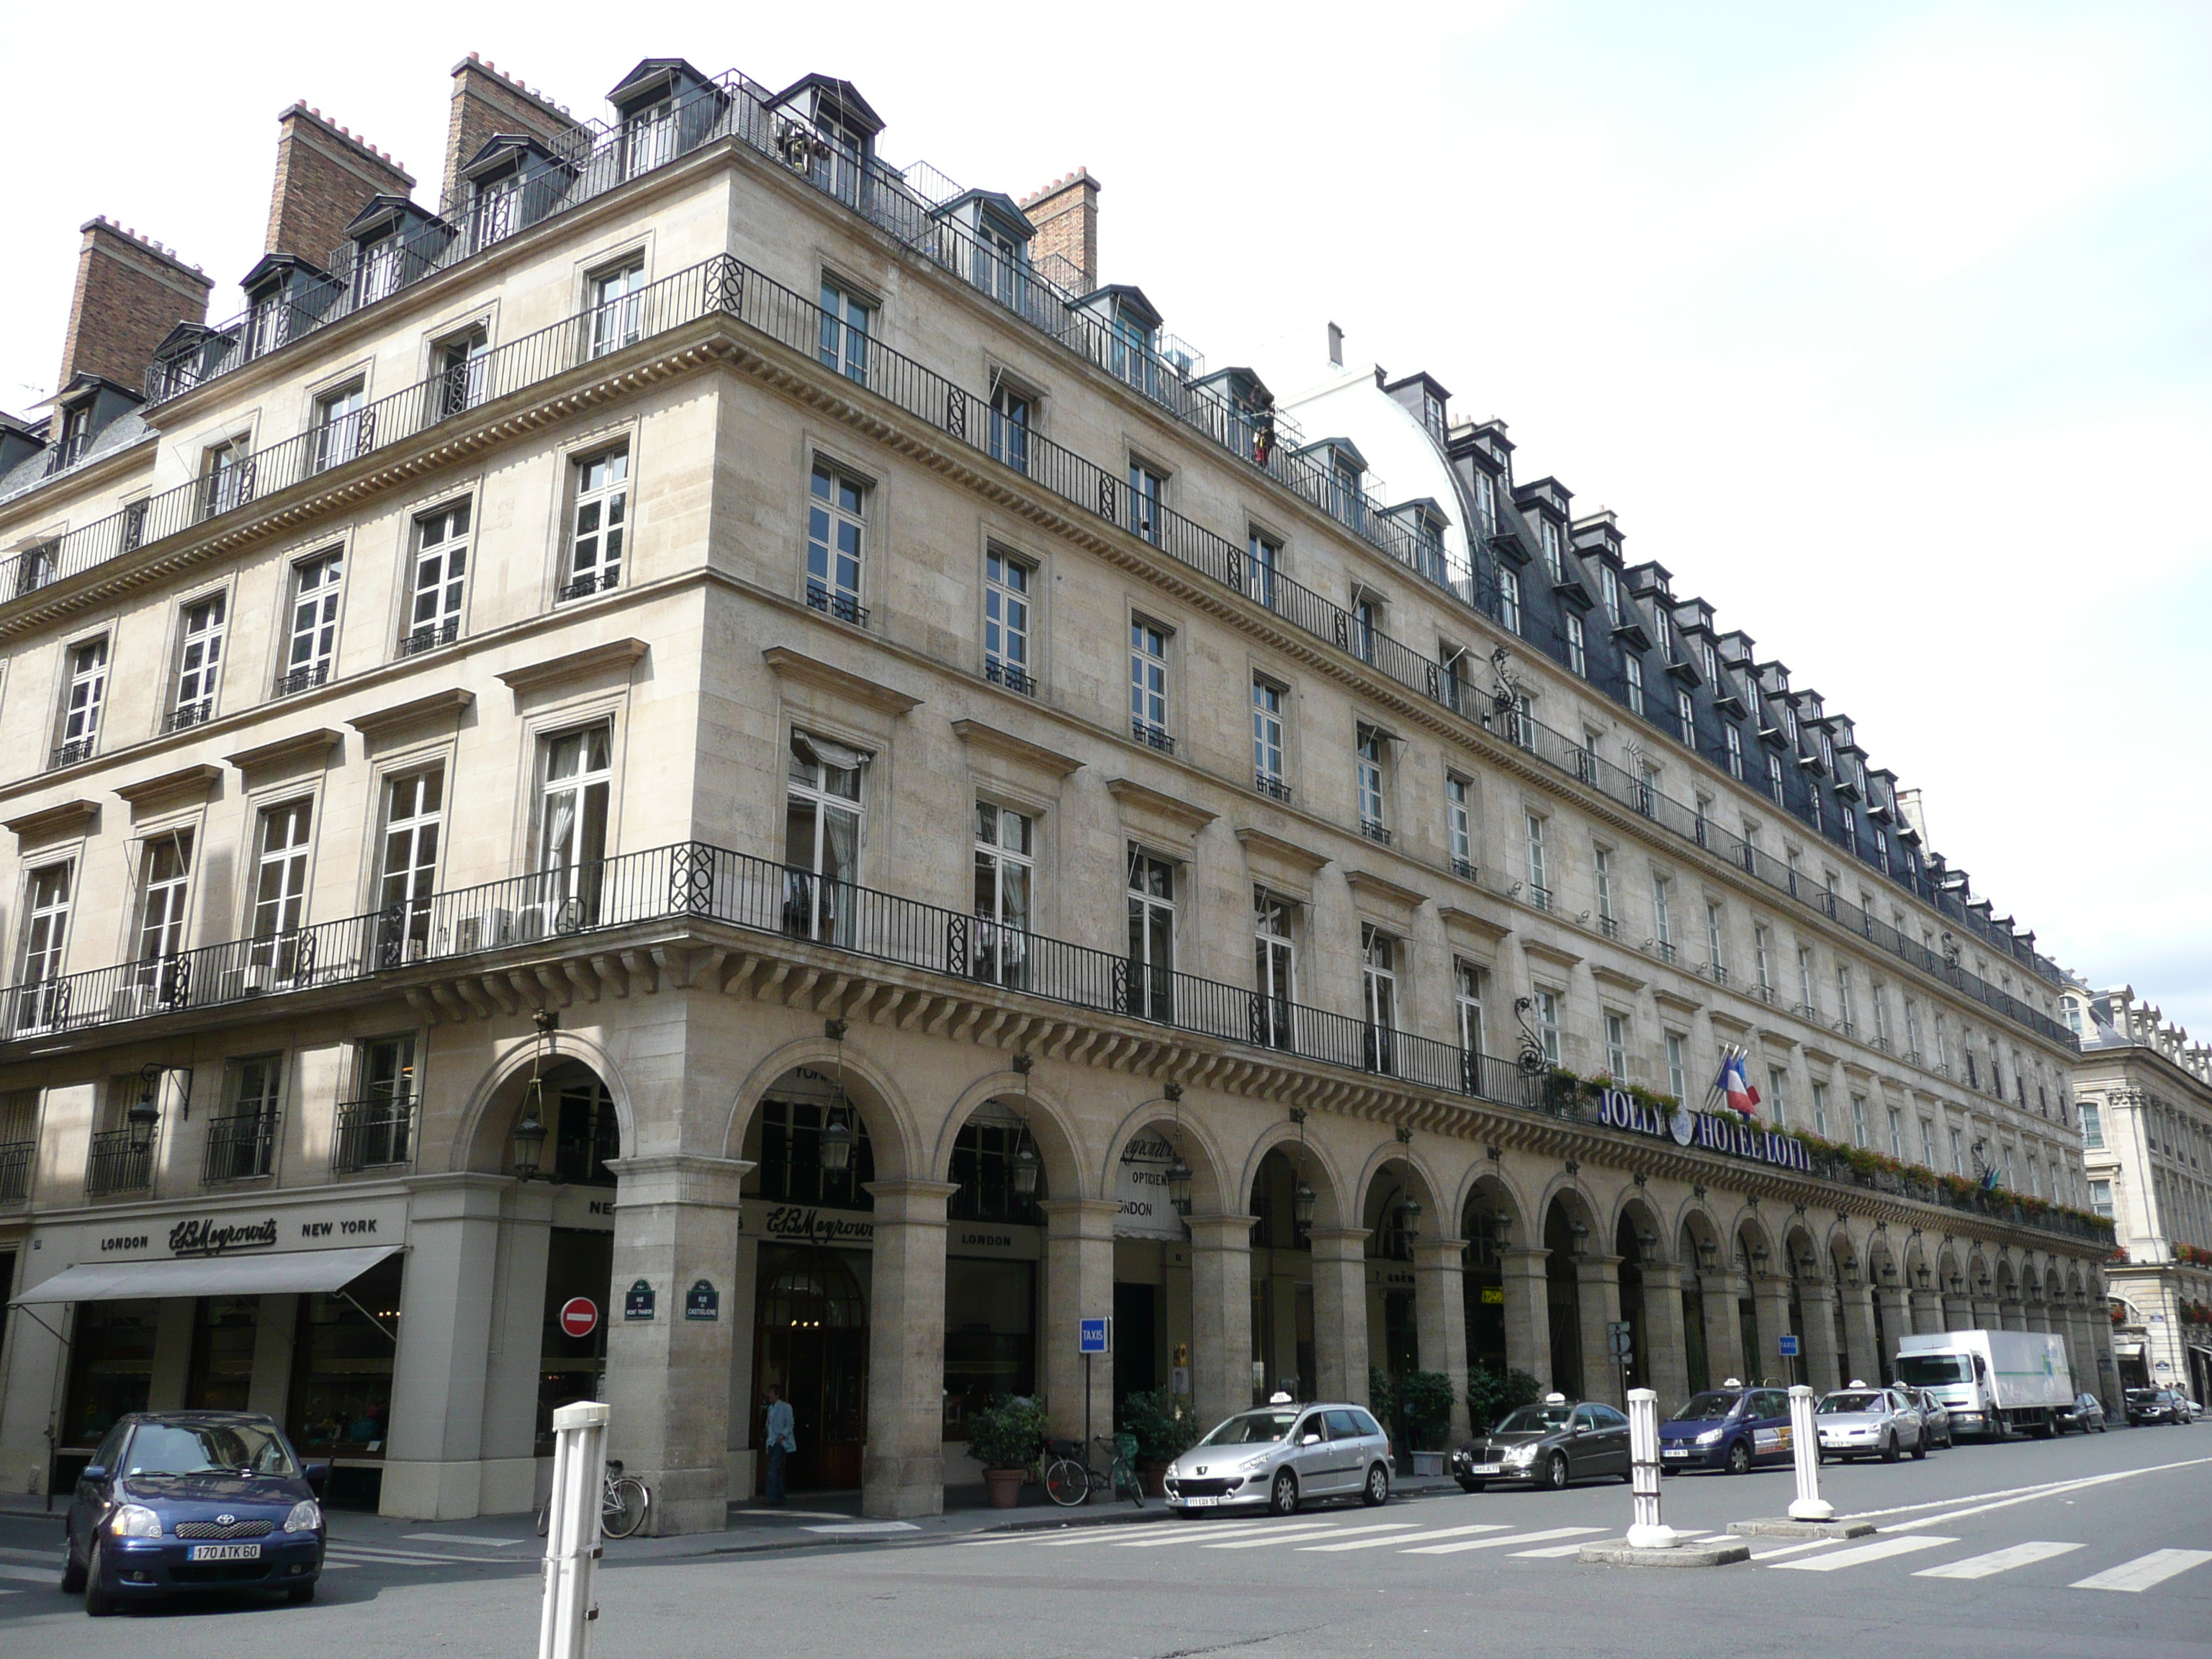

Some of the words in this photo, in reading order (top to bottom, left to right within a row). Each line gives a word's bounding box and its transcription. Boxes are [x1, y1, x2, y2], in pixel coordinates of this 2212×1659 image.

[1599, 1089, 1662, 1136] JOLLY
[1696, 1113, 1762, 1159] HOTEL
[1133, 1172, 1169, 1186] OPTICIEN
[302, 1222, 333, 1237] NEW
[341, 1219, 377, 1233] YORK
[102, 1234, 148, 1251] LONDON
[961, 1233, 1012, 1247] LONDON
[1083, 1329, 1103, 1341] TAXIS
[197, 1547, 217, 1559] 170
[220, 1547, 240, 1558] ATK
[243, 1545, 257, 1557] 60
